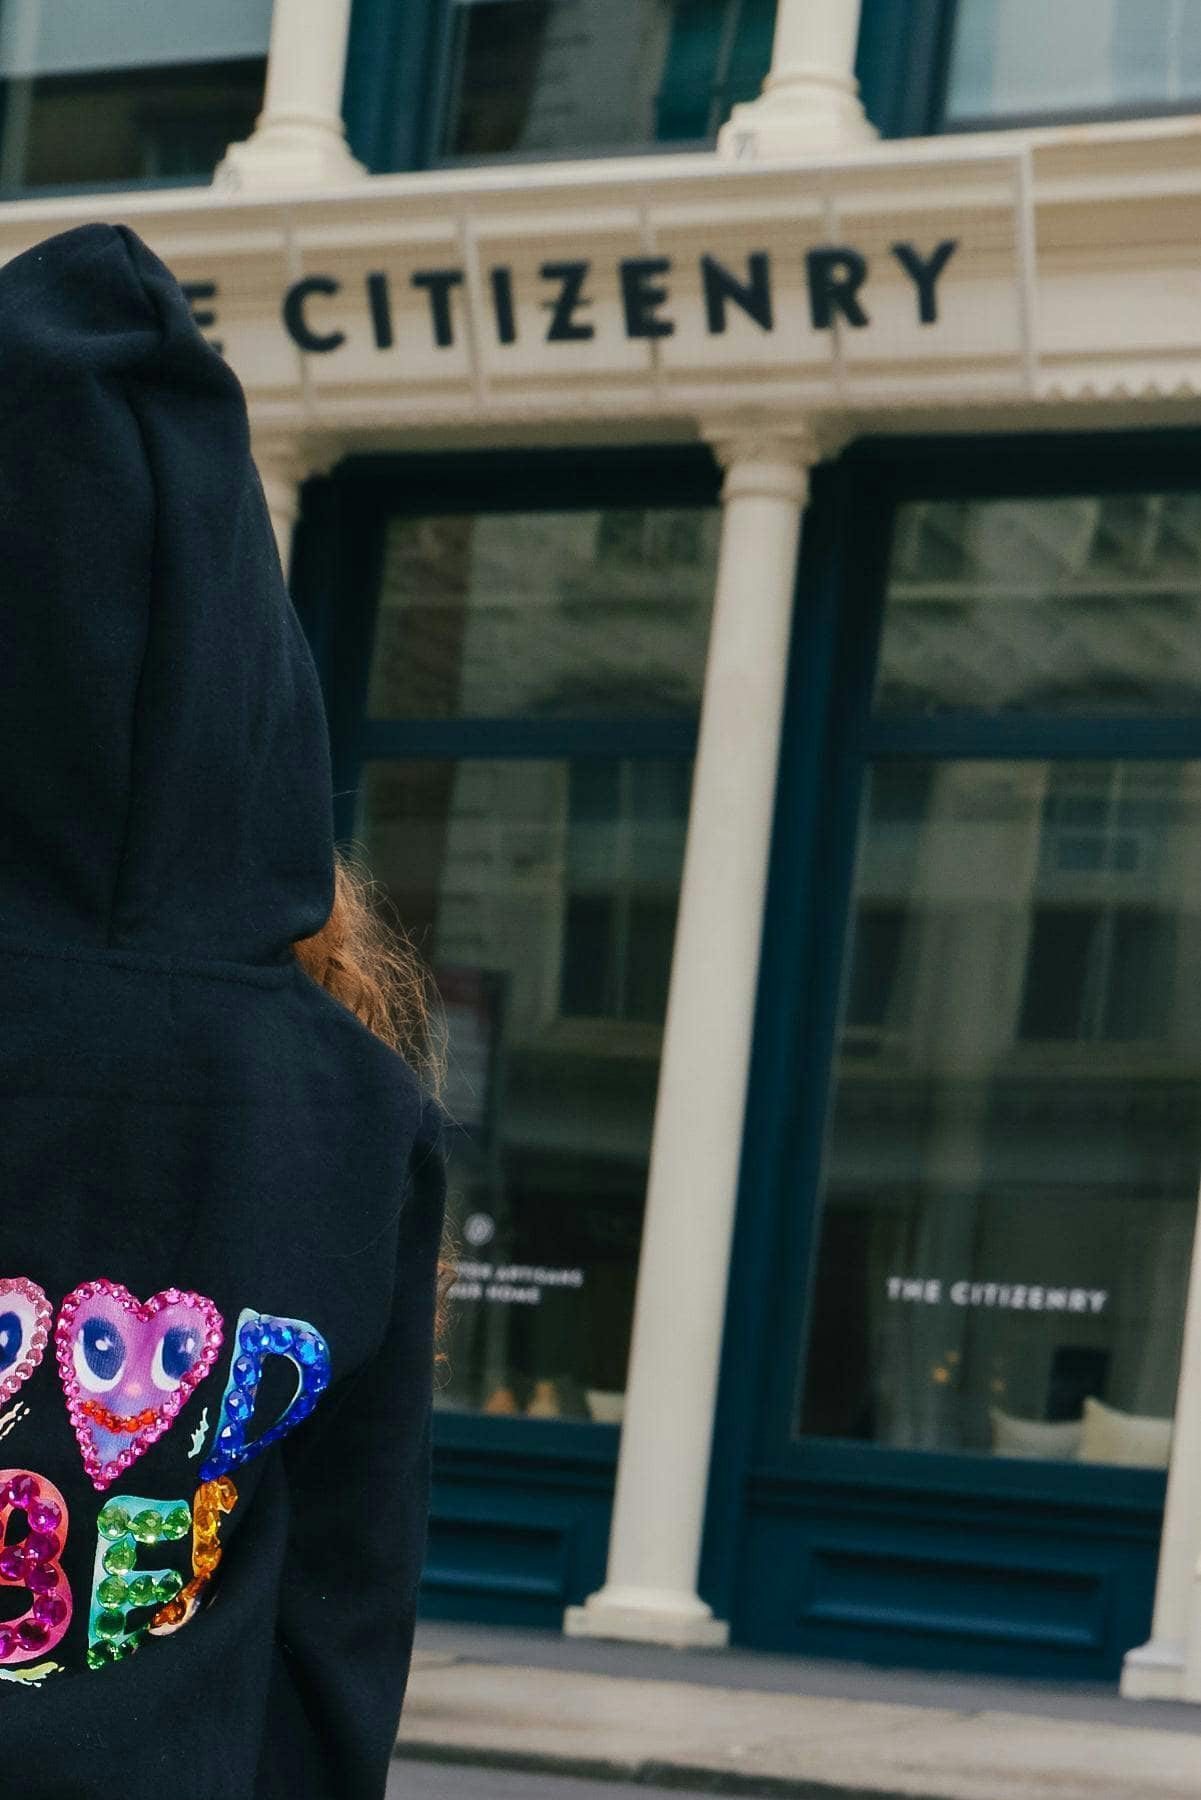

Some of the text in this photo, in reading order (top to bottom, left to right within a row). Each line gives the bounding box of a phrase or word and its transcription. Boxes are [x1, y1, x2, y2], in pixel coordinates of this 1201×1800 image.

[282, 238, 960, 353] CITIZENRY
[886, 1276, 1109, 1314] THE CITIZENRY
